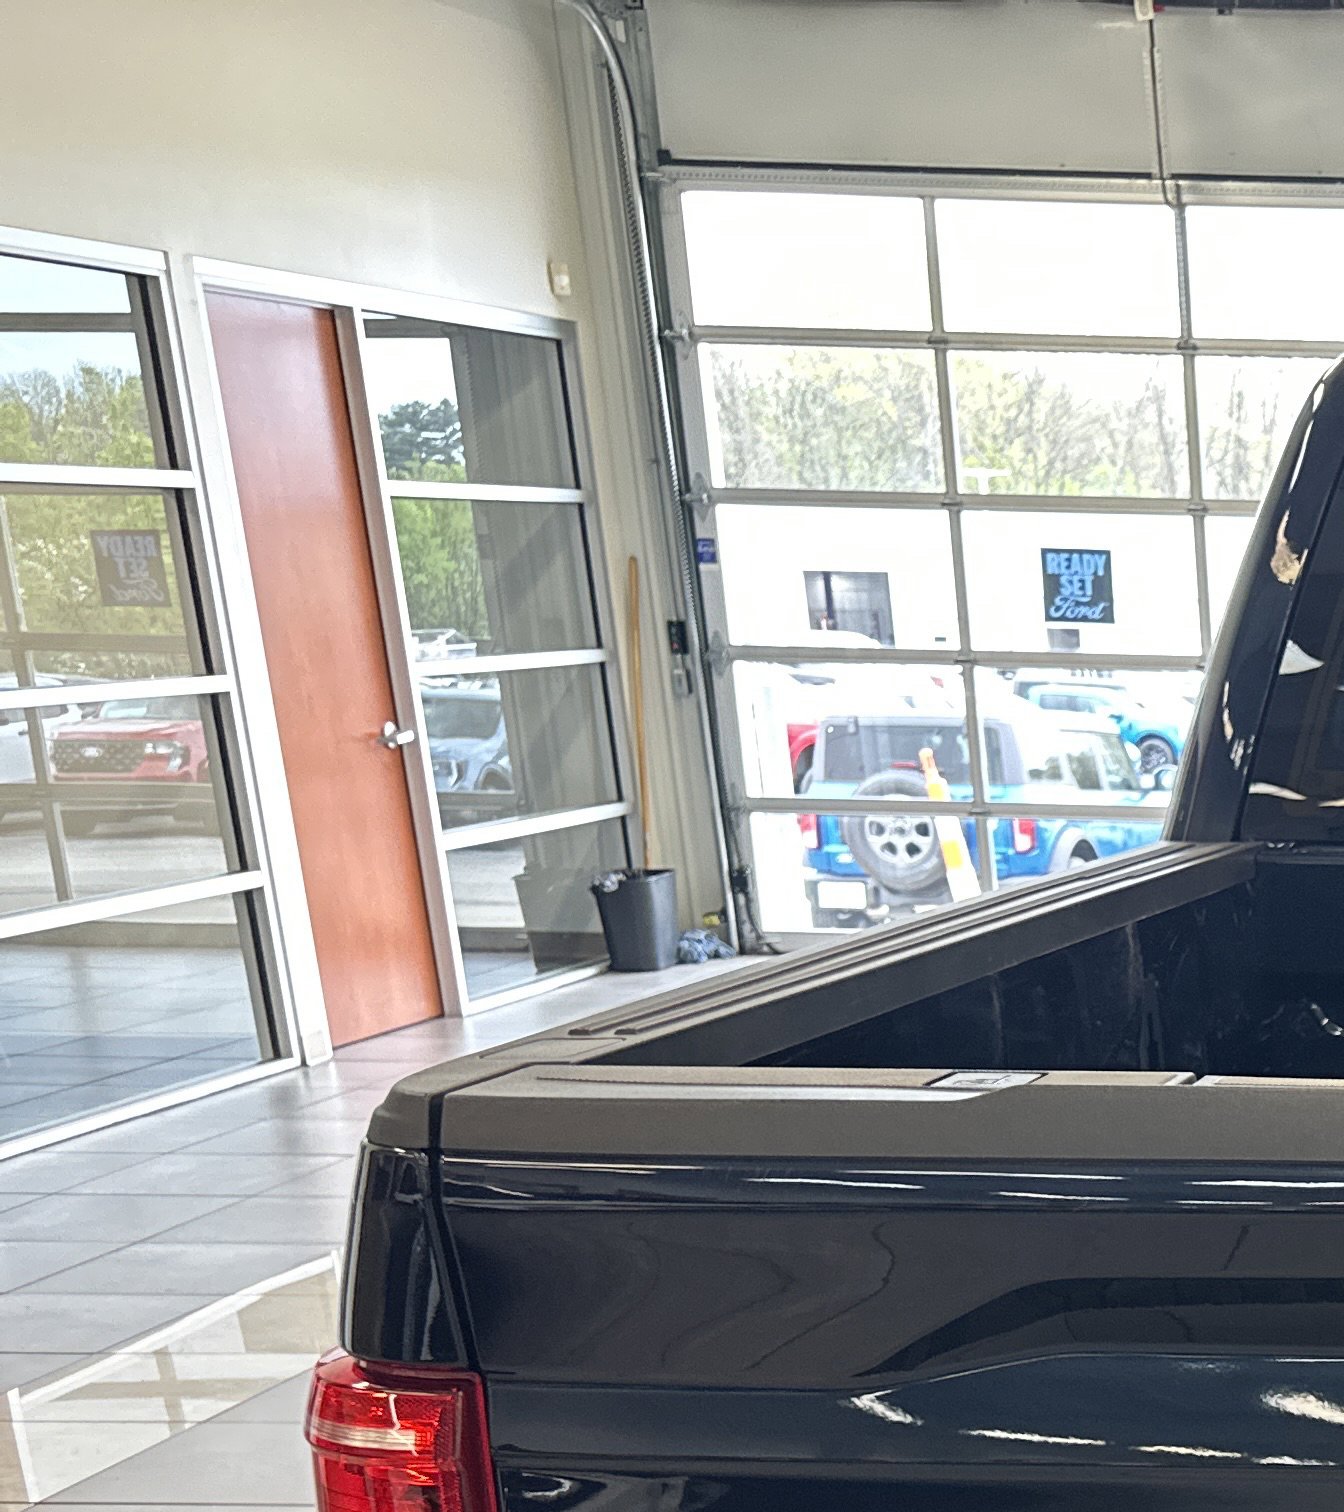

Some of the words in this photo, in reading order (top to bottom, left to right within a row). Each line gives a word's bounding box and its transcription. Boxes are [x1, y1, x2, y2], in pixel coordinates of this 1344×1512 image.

[1046, 552, 1107, 576] READY
[1059, 575, 1094, 597] SET
[1049, 595, 1110, 620] Ford
